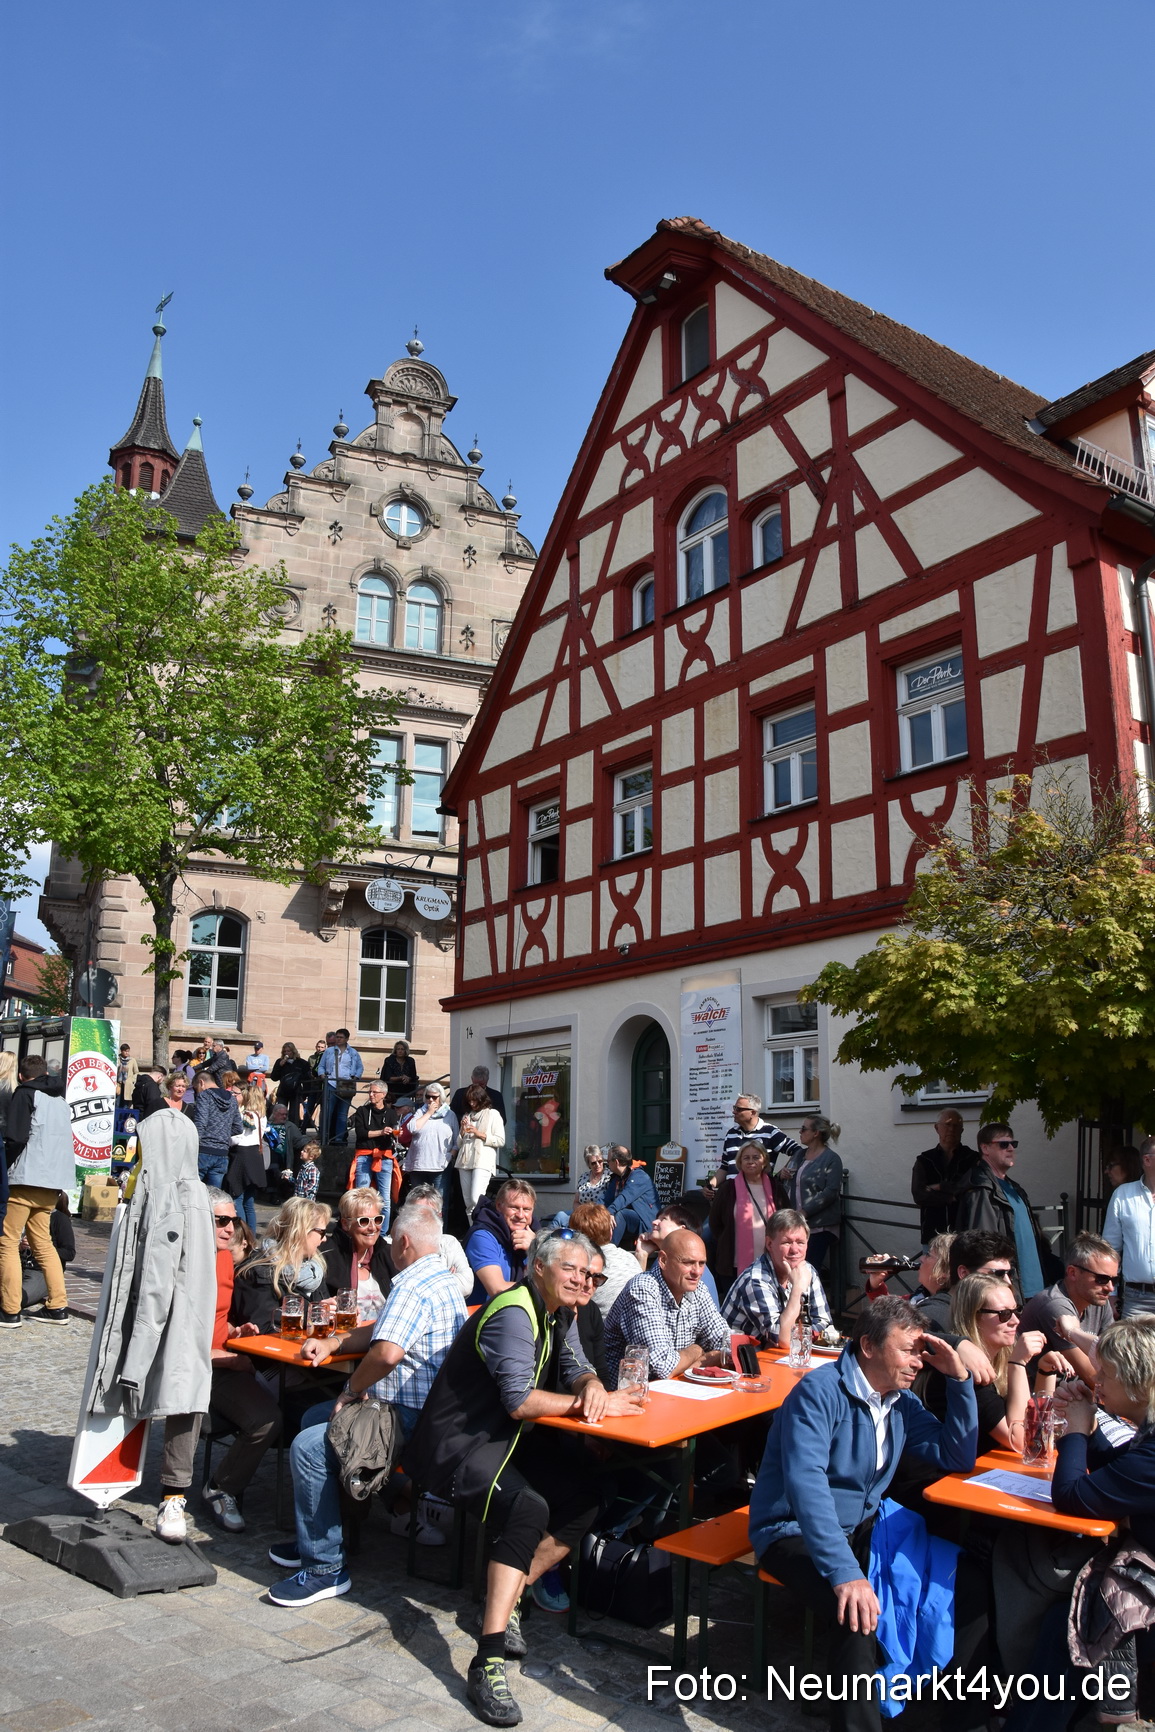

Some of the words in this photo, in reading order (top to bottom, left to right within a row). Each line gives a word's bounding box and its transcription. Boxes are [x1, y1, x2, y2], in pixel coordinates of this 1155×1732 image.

[911, 675, 932, 688] Der
[929, 662, 962, 685] Park
[416, 895, 450, 906] KRUGMANN
[424, 903, 440, 913] Optik
[699, 996, 720, 1010] FAHRSCHULE
[694, 1007, 726, 1022] walch
[466, 1026, 474, 1039] 14
[525, 1072, 554, 1085] walch
